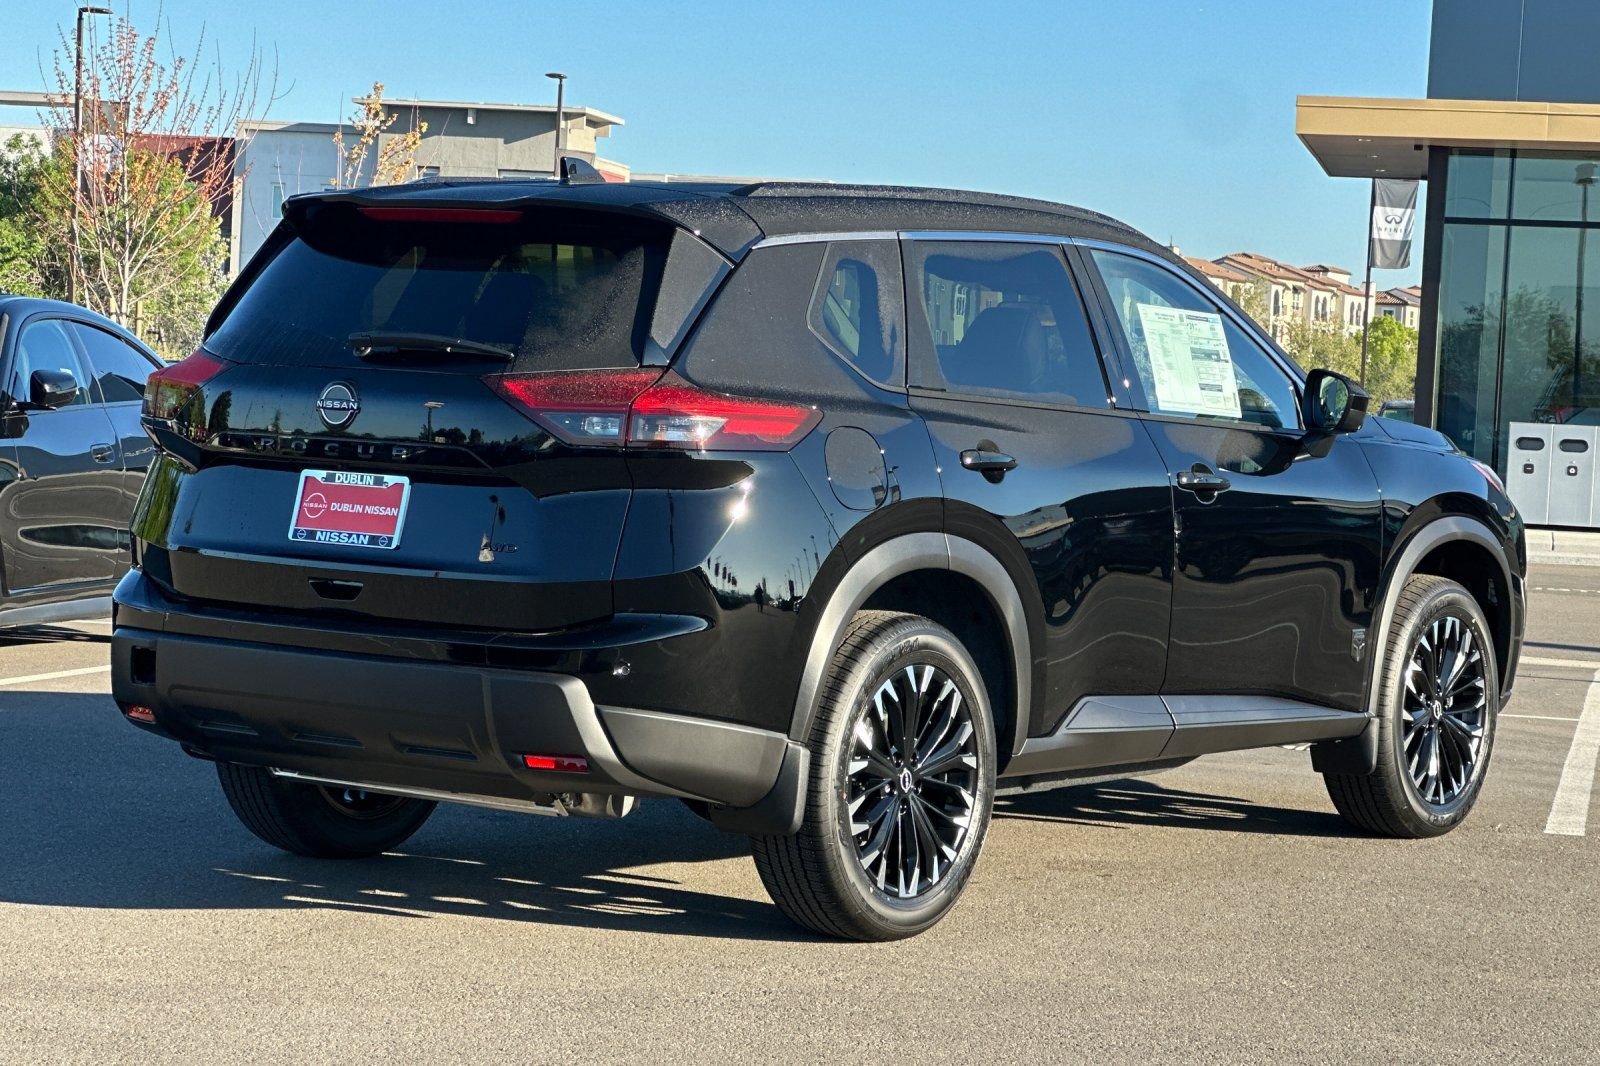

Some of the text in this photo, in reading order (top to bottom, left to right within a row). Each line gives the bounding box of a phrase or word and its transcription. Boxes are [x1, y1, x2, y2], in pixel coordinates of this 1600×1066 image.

[316, 400, 358, 410] NISSAN
[259, 437, 410, 460] ROGUE
[335, 473, 374, 485] DUBLIN
[330, 502, 399, 517] DUBLIN NISSAN
[315, 531, 369, 545] NISSAN
